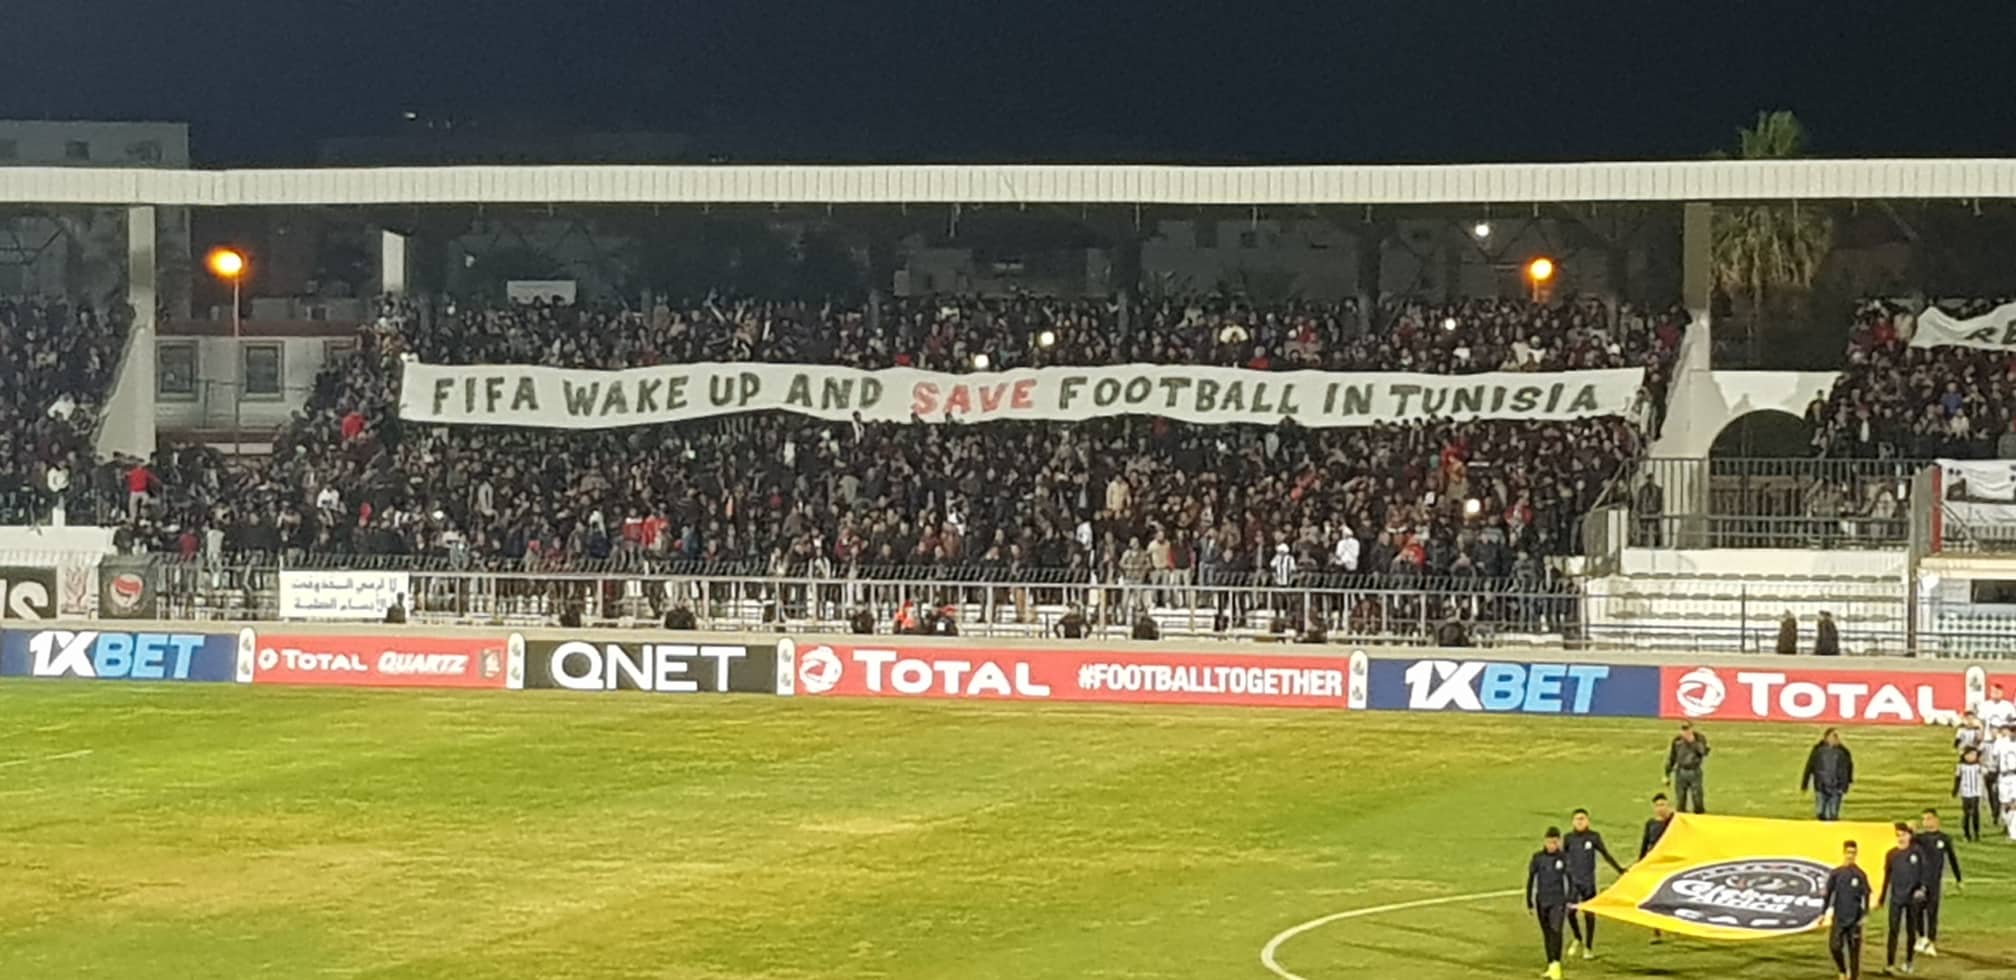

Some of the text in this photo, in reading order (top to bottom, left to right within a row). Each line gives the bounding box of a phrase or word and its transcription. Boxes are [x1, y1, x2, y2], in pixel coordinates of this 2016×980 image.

[432, 372, 1602, 417] FIFA WAKE UP AND SAVE FOOTBALL IN TUNISIA
[29, 631, 205, 677] 1XBET
[281, 648, 470, 676] TOTAL QUARTZ
[550, 641, 747, 692] QNET
[852, 649, 1343, 698] TOTAL #FOOTBALLTOGETHER
[1404, 659, 1610, 715] 1XBET
[1737, 672, 1959, 721] TOTAL
